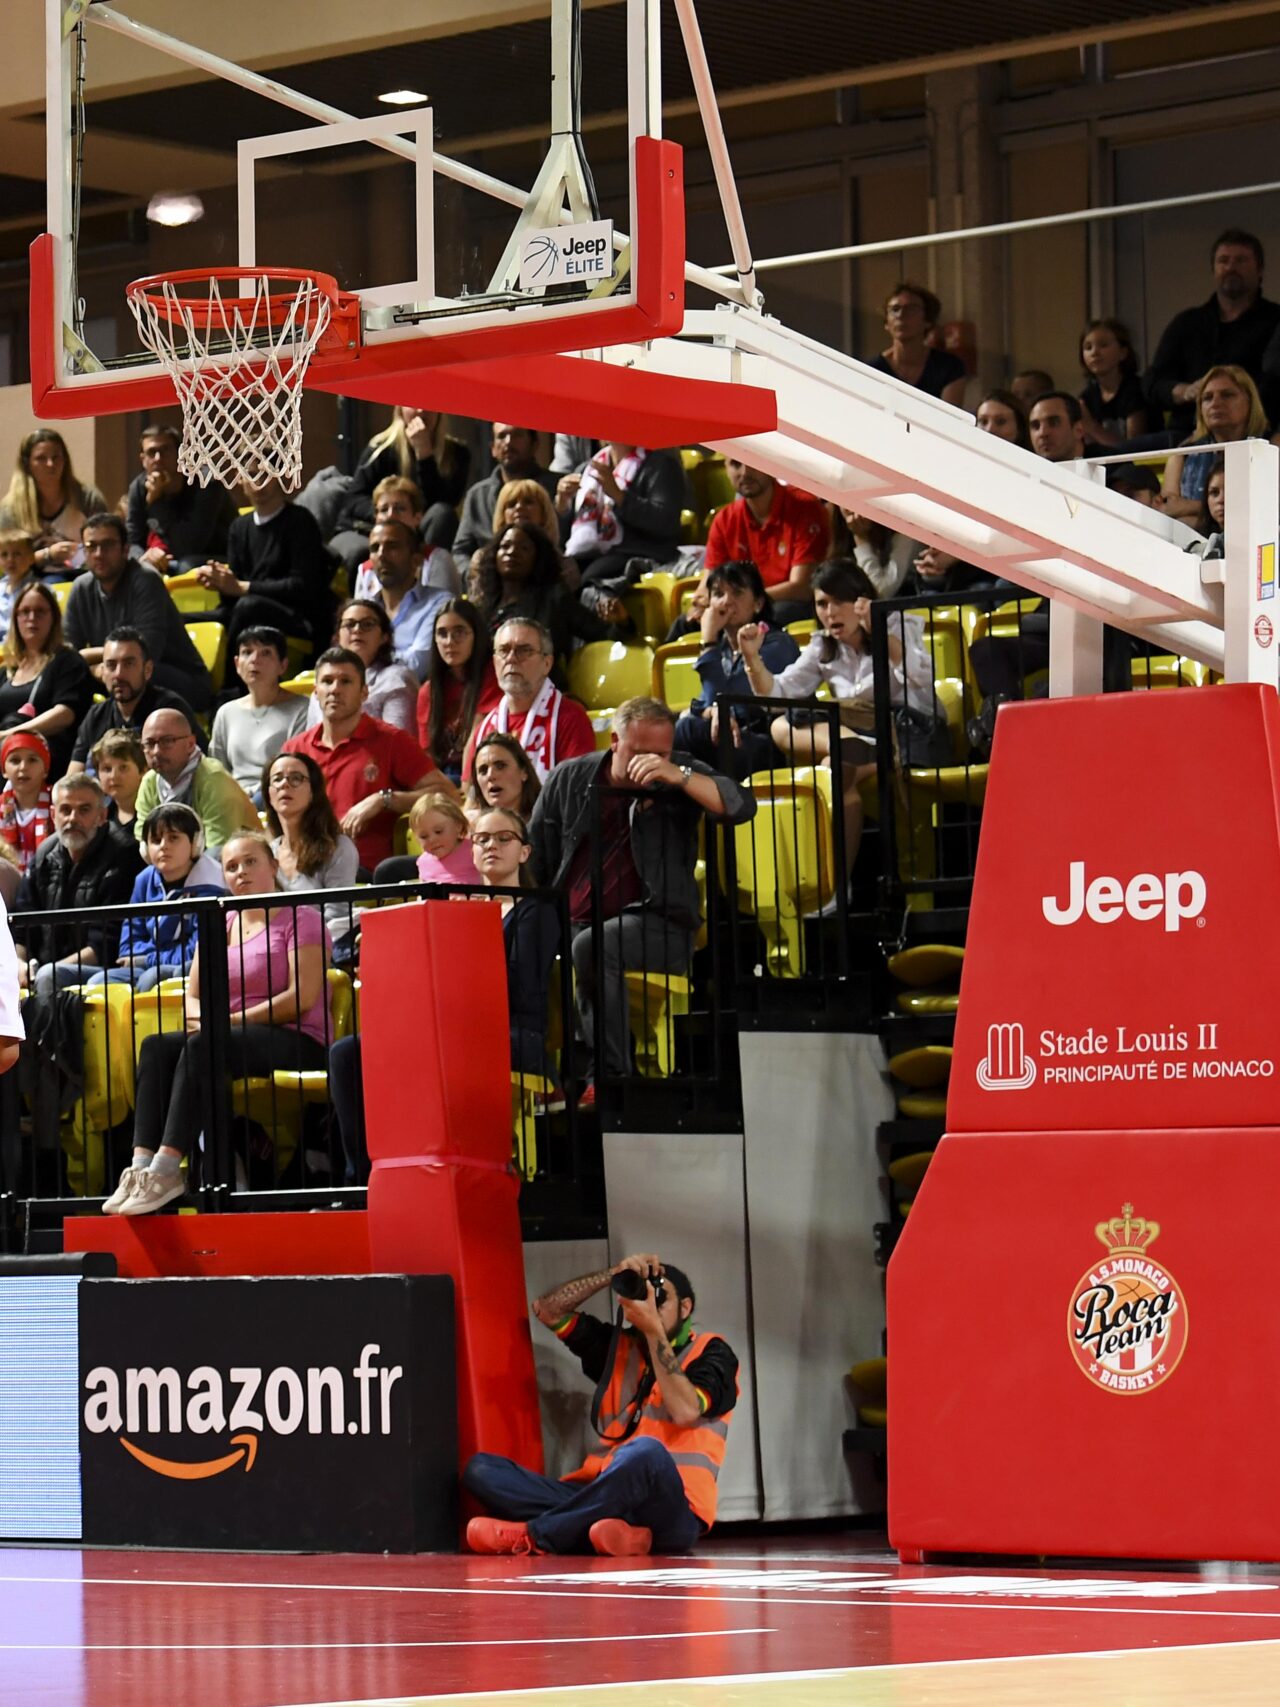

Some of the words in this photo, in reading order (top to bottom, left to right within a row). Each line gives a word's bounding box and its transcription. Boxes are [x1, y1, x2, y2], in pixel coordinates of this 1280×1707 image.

[562, 237, 607, 256] Jeep
[565, 257, 604, 275] ÉLITE
[1042, 861, 1207, 932] Jeep
[1040, 1027, 1108, 1057] Stade
[1116, 1024, 1188, 1052] Louis
[1197, 1023, 1218, 1050] II
[1043, 1059, 1158, 1083] PRINCIPAUTÉ
[1163, 1062, 1186, 1079] DE
[1192, 1059, 1274, 1080] MONACO
[1074, 1284, 1176, 1340] Roca
[84, 1343, 403, 1435] amazon.fr
[1099, 1370, 1155, 1390] BASKET
